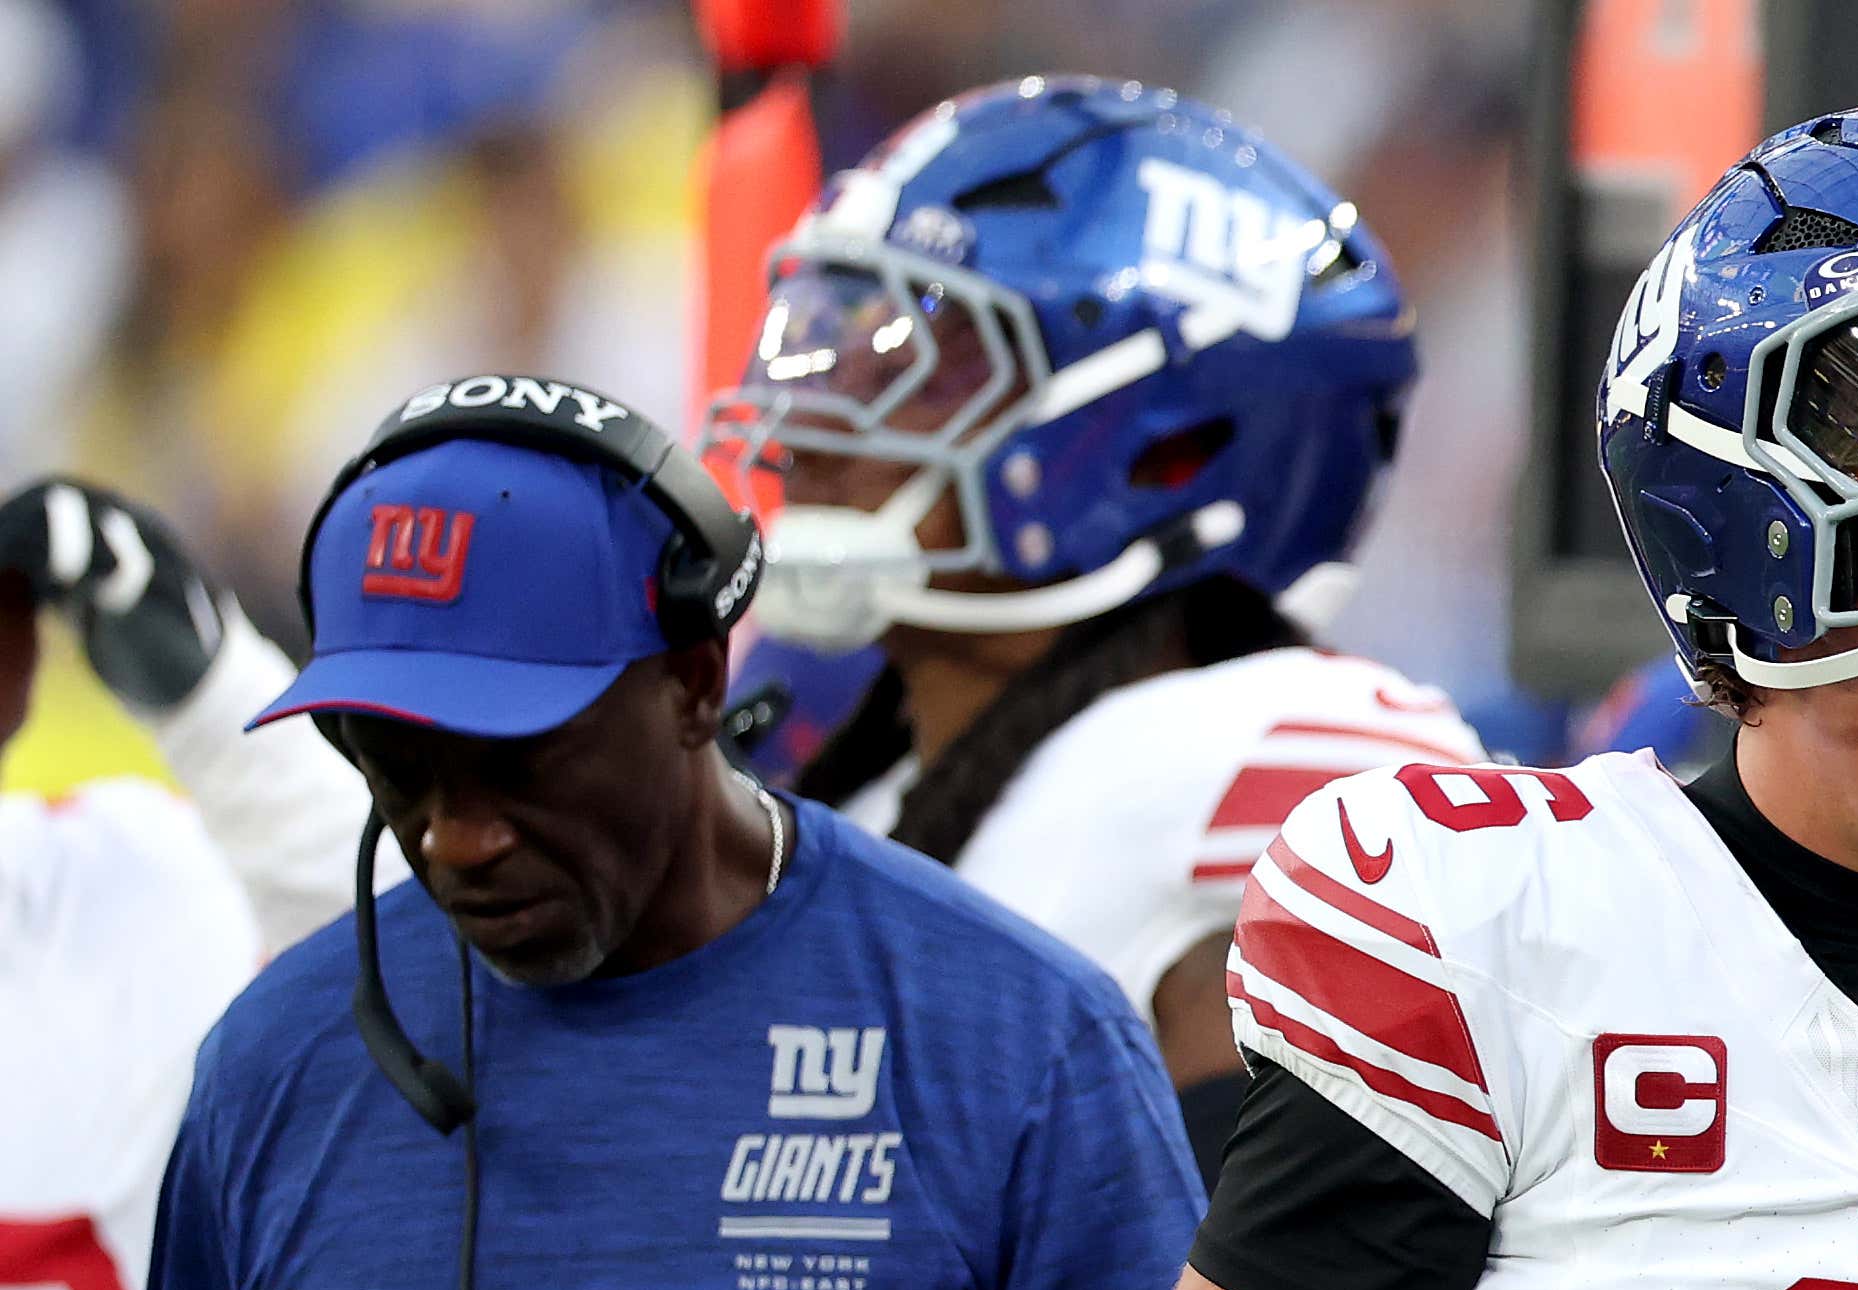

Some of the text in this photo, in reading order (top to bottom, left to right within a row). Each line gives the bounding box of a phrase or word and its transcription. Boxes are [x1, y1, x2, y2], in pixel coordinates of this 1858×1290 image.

[400, 375, 629, 432] SONY
[1603, 1044, 1718, 1137] C
[720, 1133, 903, 1204] GIANTS
[735, 1253, 870, 1274] NEW YORK
